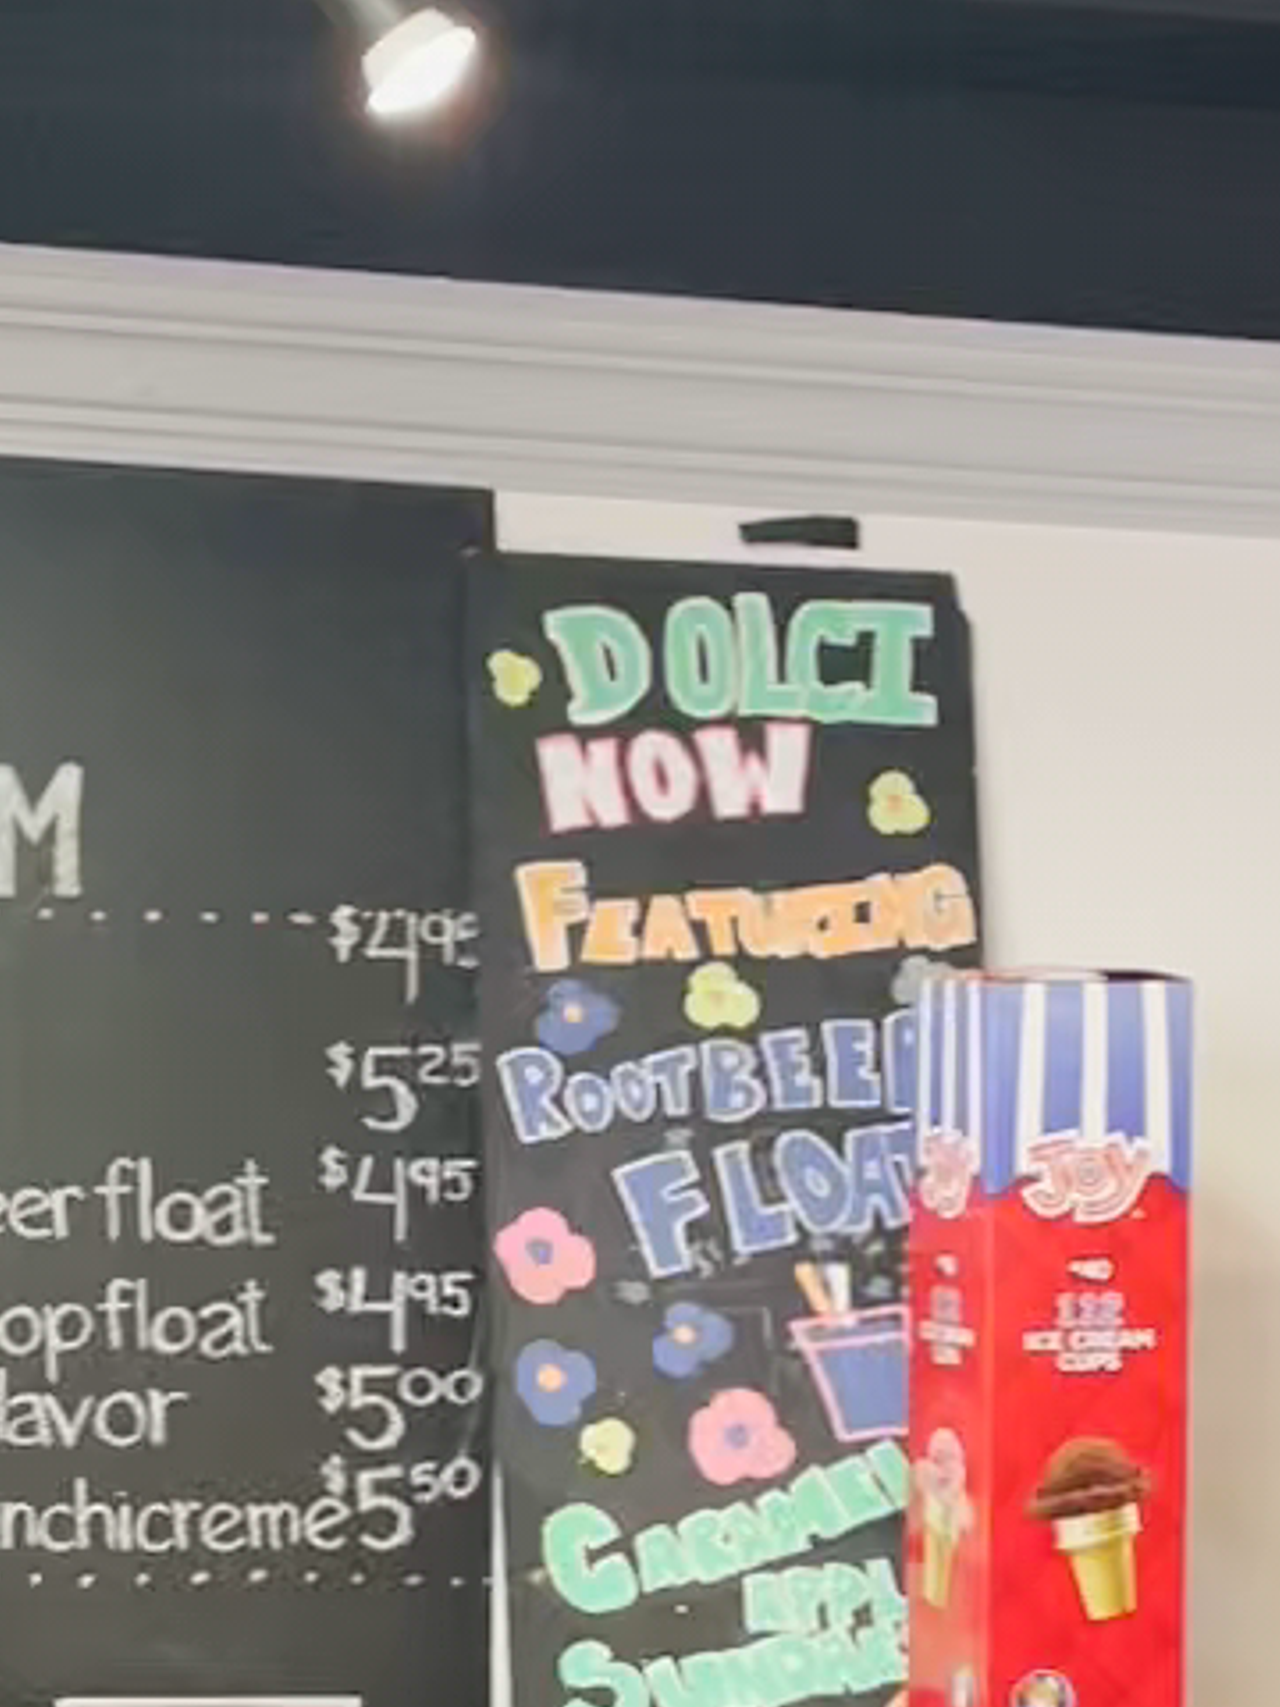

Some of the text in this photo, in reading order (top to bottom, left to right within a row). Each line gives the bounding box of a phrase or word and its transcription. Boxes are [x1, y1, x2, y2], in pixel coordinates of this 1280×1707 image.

[541, 592, 938, 727] DOLCI
[536, 722, 811, 834] NOW
[93, 1157, 276, 1246] float
[103, 1278, 273, 1355] float
